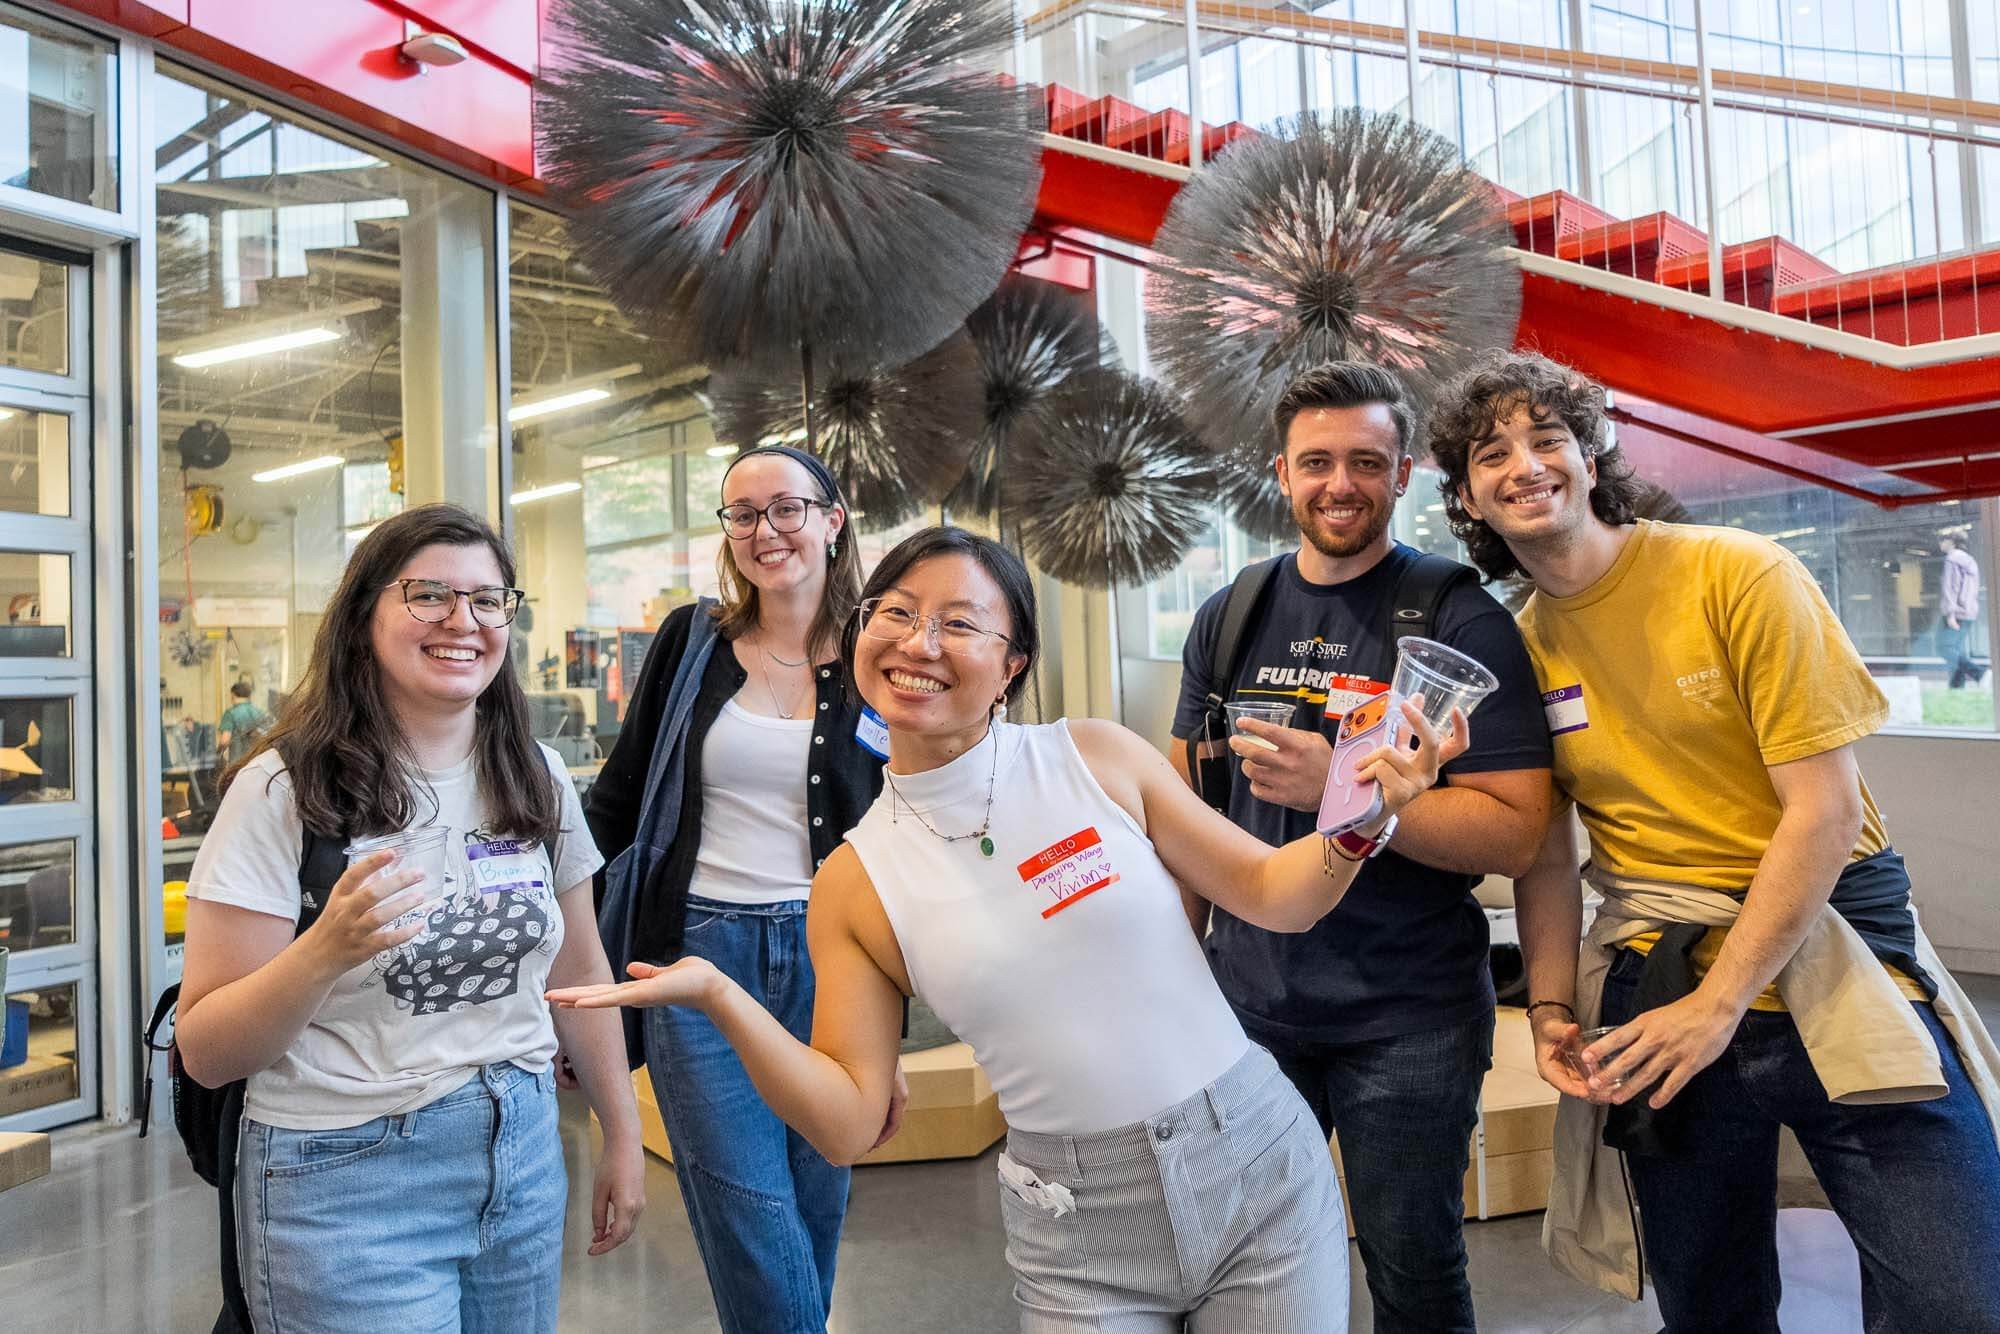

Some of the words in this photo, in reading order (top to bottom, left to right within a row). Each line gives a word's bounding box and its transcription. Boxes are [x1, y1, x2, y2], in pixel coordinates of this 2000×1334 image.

[1316, 641, 1348, 656] STATE
[1345, 679, 1372, 690] HELLO
[1676, 667, 1720, 688] GUFO
[486, 840, 517, 852] HELLO
[1039, 839, 1076, 865] HELLO
[1074, 846, 1104, 862] Wang
[1048, 869, 1103, 901] Vivian
